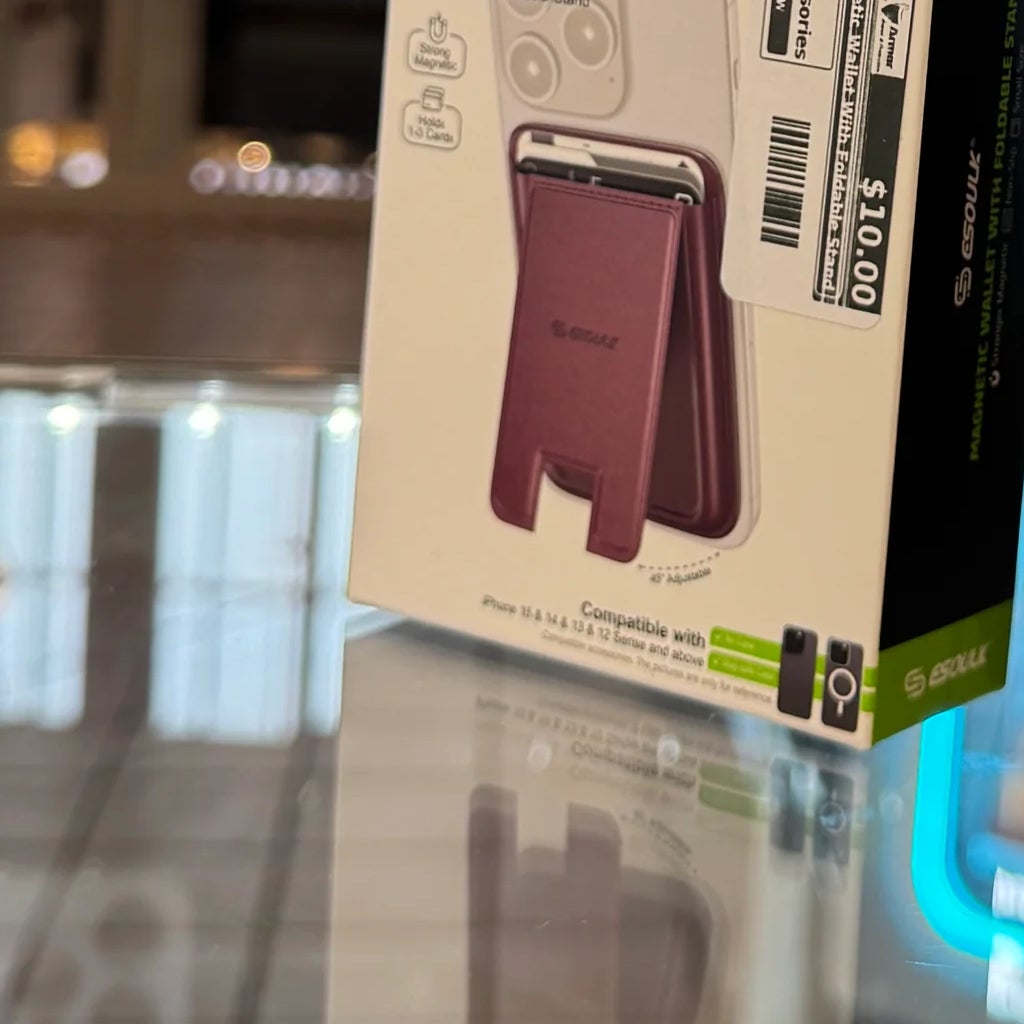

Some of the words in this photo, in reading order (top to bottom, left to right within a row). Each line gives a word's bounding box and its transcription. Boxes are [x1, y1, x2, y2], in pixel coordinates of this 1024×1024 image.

[843, 35, 861, 94] Wallet
[838, 101, 854, 141] With
[993, 55, 1014, 169] FOLDABLE
[829, 150, 850, 231] Foldable
[988, 177, 1003, 240] WITH
[823, 238, 840, 291] Stand
[851, 176, 888, 306] $10.00
[980, 248, 997, 337] WALLET
[969, 341, 989, 461] MAGNETIC
[581, 600, 669, 639] Compatible
[673, 628, 706, 648] with
